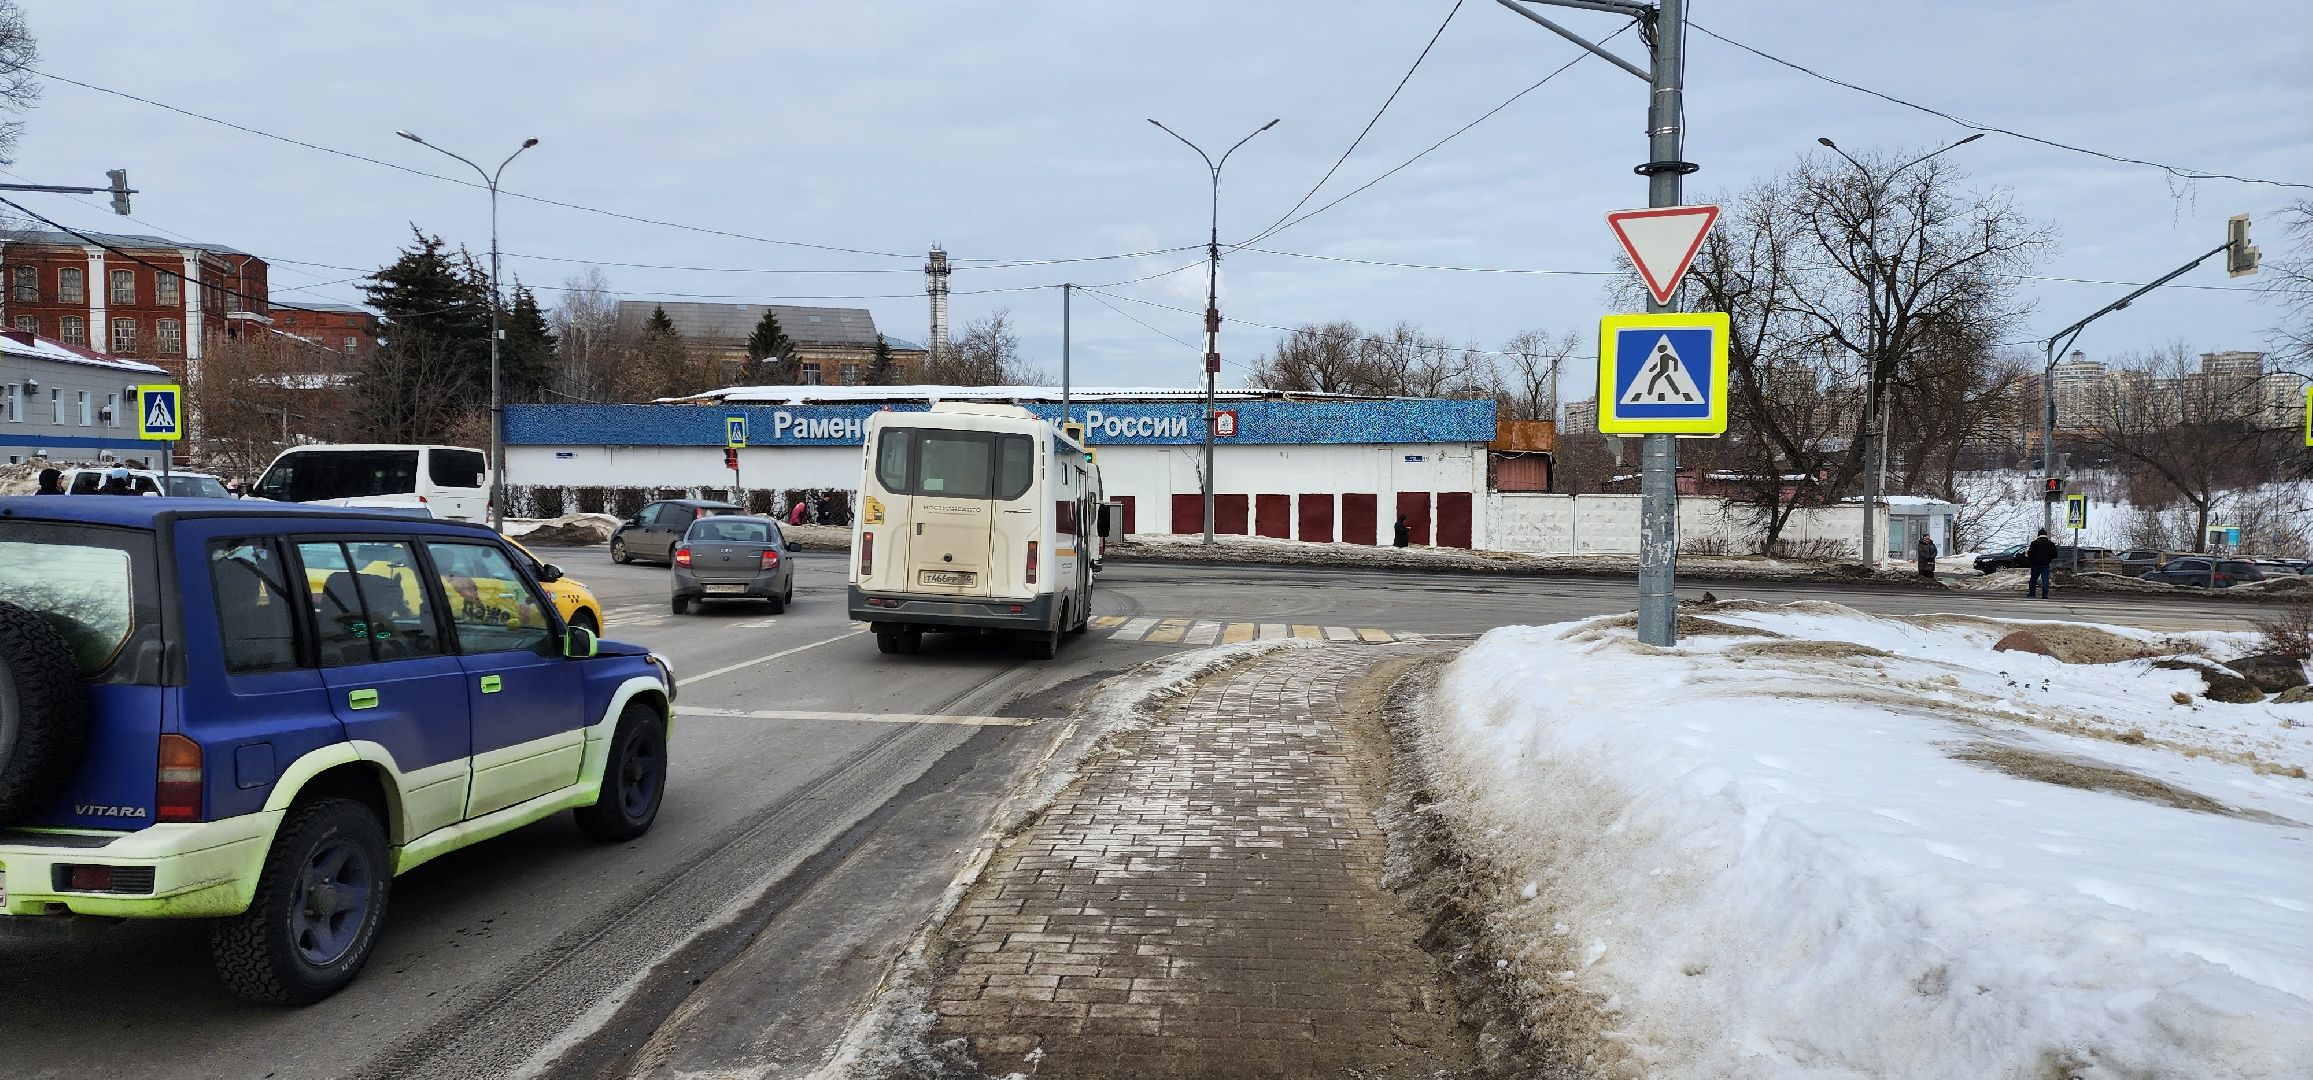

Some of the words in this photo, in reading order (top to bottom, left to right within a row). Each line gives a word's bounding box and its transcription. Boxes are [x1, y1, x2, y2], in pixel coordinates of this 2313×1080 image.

[774, 411, 868, 439] Рамен
[1087, 411, 1187, 437] России
[75, 805, 146, 817] VITARA
